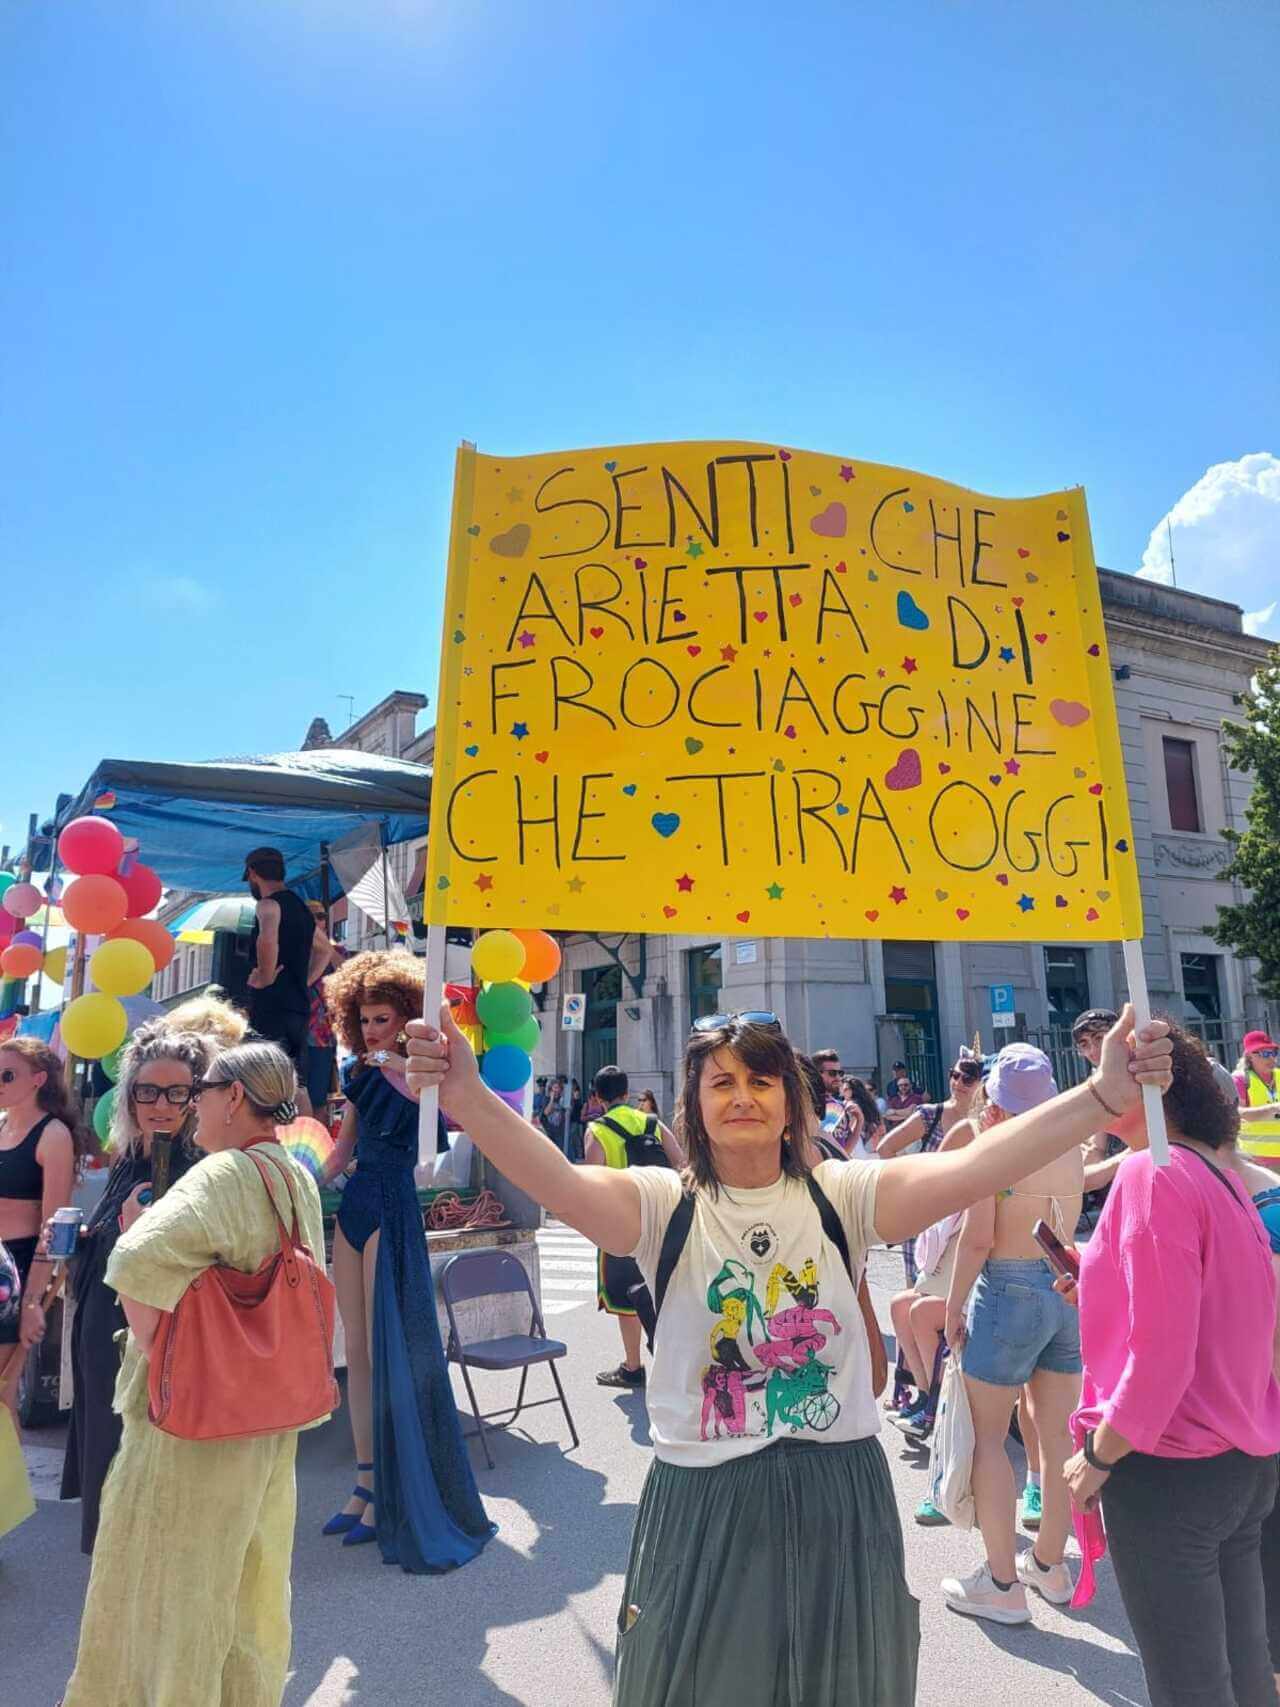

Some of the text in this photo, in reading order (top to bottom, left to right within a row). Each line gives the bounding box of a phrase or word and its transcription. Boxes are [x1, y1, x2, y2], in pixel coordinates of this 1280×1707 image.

[534, 454, 1008, 588] SENTI CHE
[505, 563, 1033, 685] ARIETTA DI
[491, 656, 1057, 756] FROCIAGGINE
[446, 768, 1110, 881] CHE TIRA OGGI
[994, 988, 1008, 1011] P
